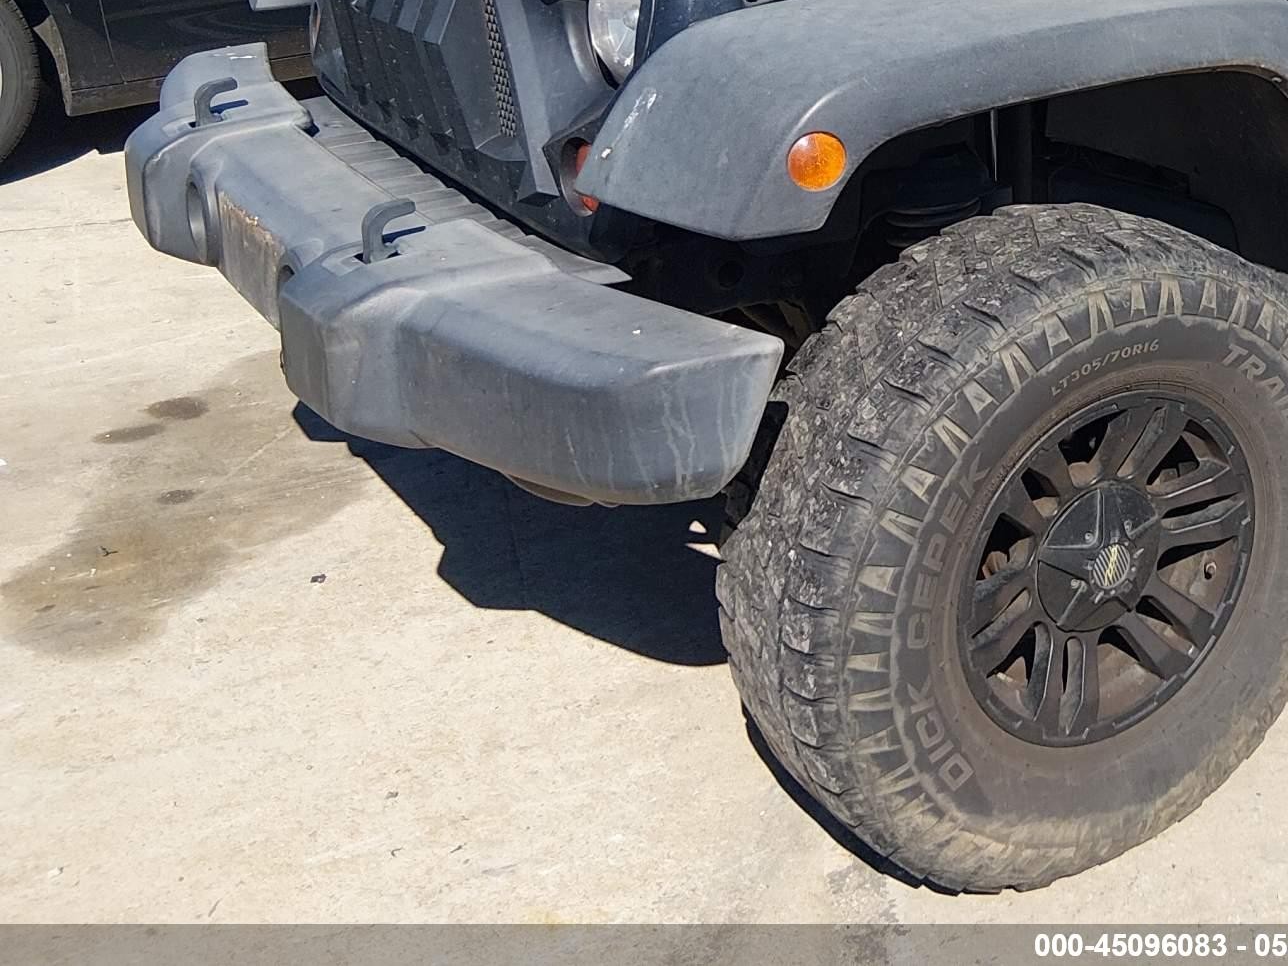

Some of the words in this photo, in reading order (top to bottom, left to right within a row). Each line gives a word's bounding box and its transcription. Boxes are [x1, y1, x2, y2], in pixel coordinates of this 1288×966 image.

[1051, 338, 1160, 396] LT305/70R16
[906, 451, 991, 650] CEPEK
[907, 674, 975, 792] DICK
